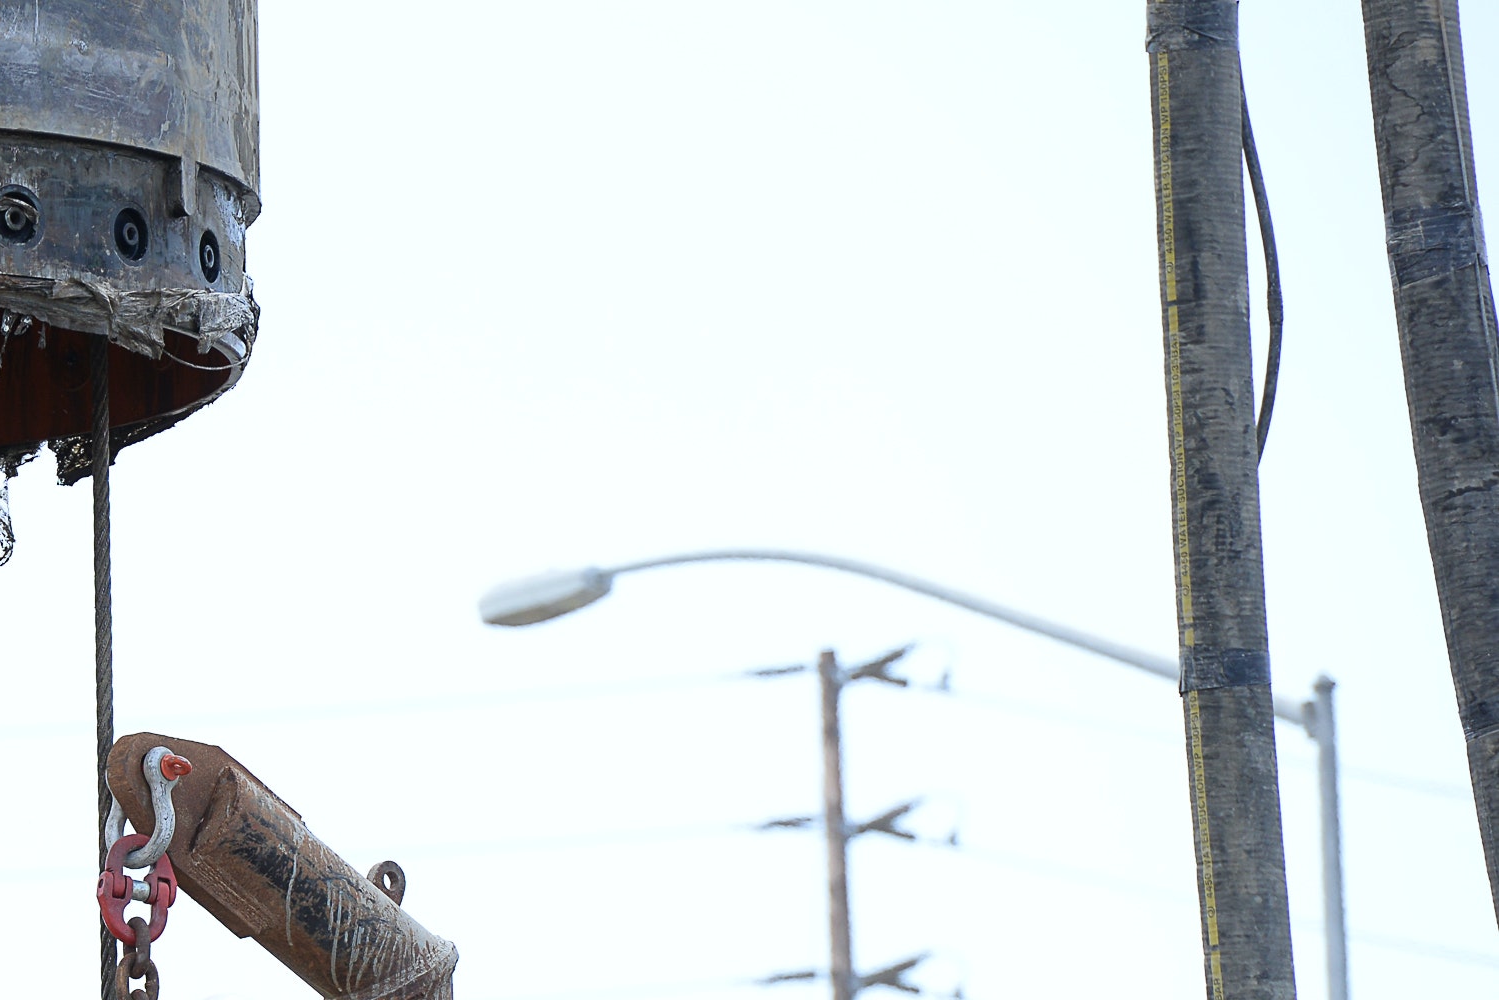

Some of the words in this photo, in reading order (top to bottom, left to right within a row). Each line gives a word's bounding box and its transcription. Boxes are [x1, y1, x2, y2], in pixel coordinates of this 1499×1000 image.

[1159, 65, 1168, 103] 150PSI
[1160, 106, 1169, 124] WP
[1160, 128, 1170, 179] SUCTION
[1162, 183, 1172, 224] WATER
[1175, 452, 1185, 503] SUCTION
[1178, 507, 1187, 548] WATER
[1194, 753, 1202, 769] WP
[1196, 774, 1207, 825] SUCTION
[1204, 873, 1214, 899] 4450
